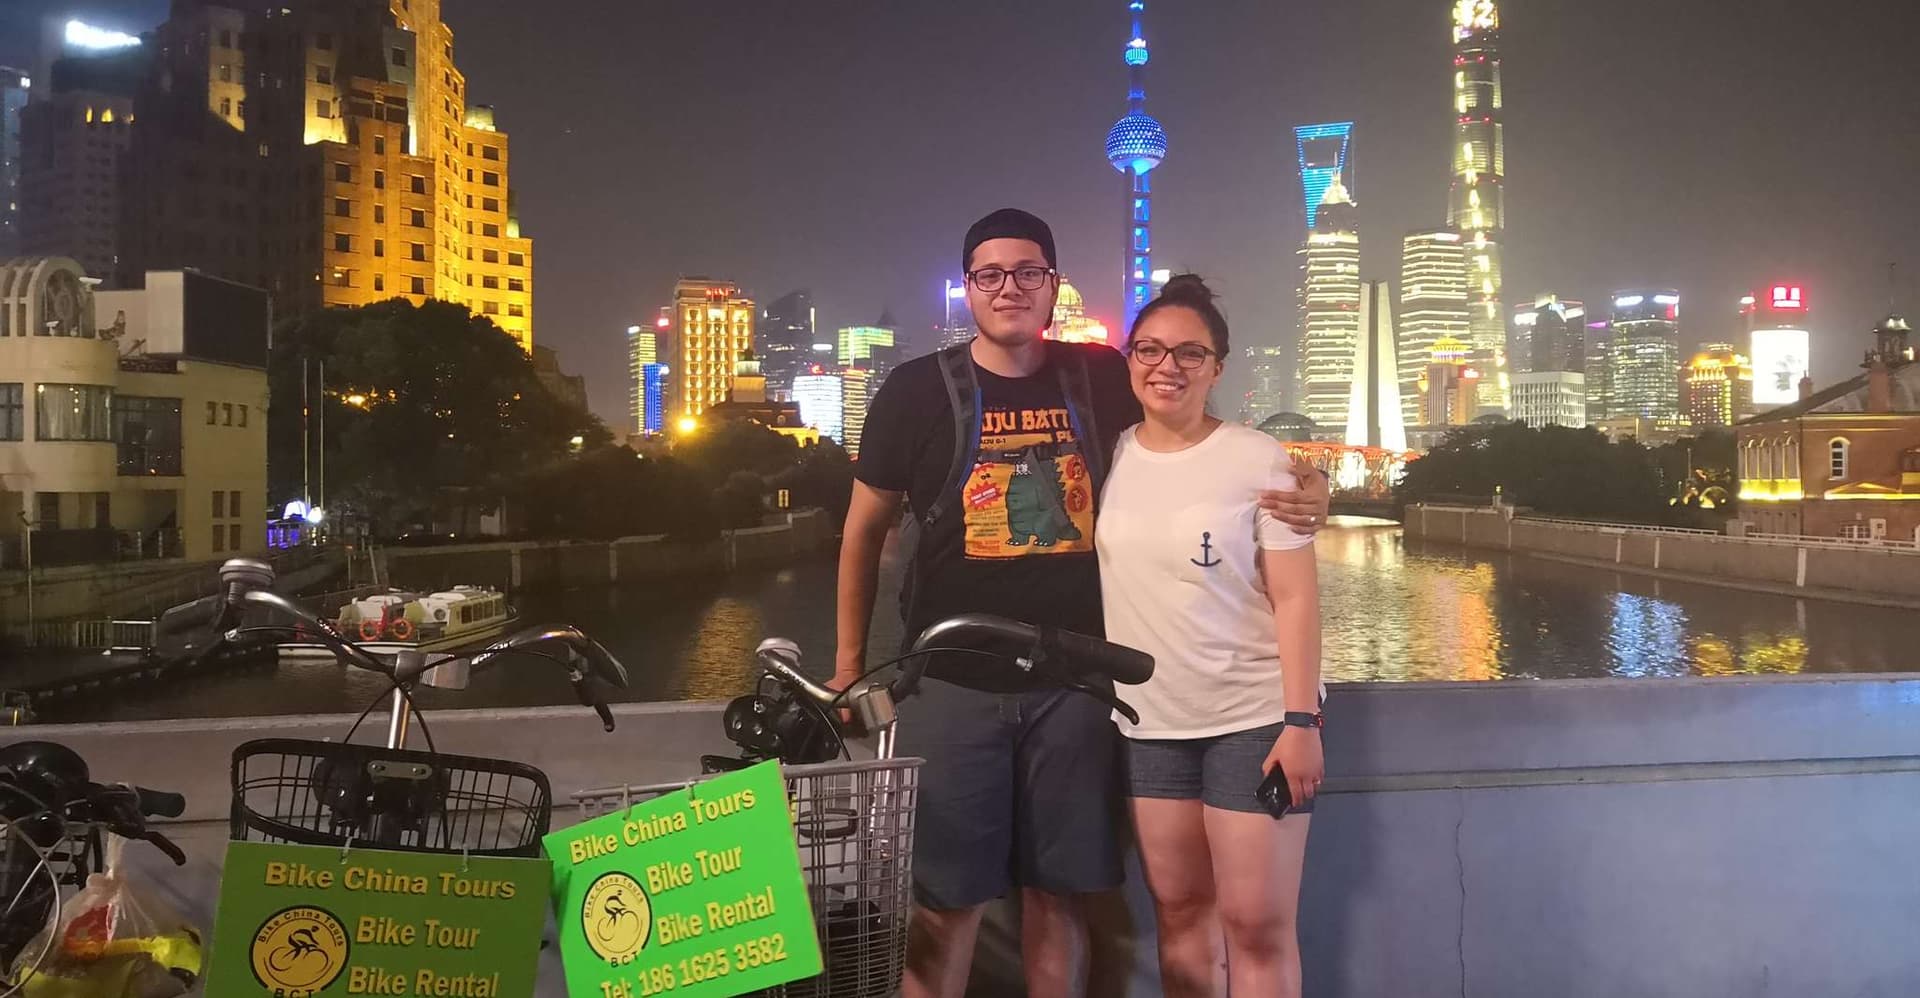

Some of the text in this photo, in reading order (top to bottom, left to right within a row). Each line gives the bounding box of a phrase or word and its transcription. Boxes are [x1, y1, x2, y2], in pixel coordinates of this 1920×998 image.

[569, 788, 756, 865] Bike China Tours
[265, 861, 517, 899] Bike China Tours
[646, 846, 742, 895] Bike Tour
[258, 911, 344, 946] Bike China Tours
[356, 915, 481, 949] Bike Tour
[656, 886, 776, 946] Bike Rental
[601, 932, 787, 998] Tel: 186 1625 3582
[611, 951, 638, 968] BCT
[274, 988, 314, 998] BCT
[348, 966, 499, 998] Bike Rental
